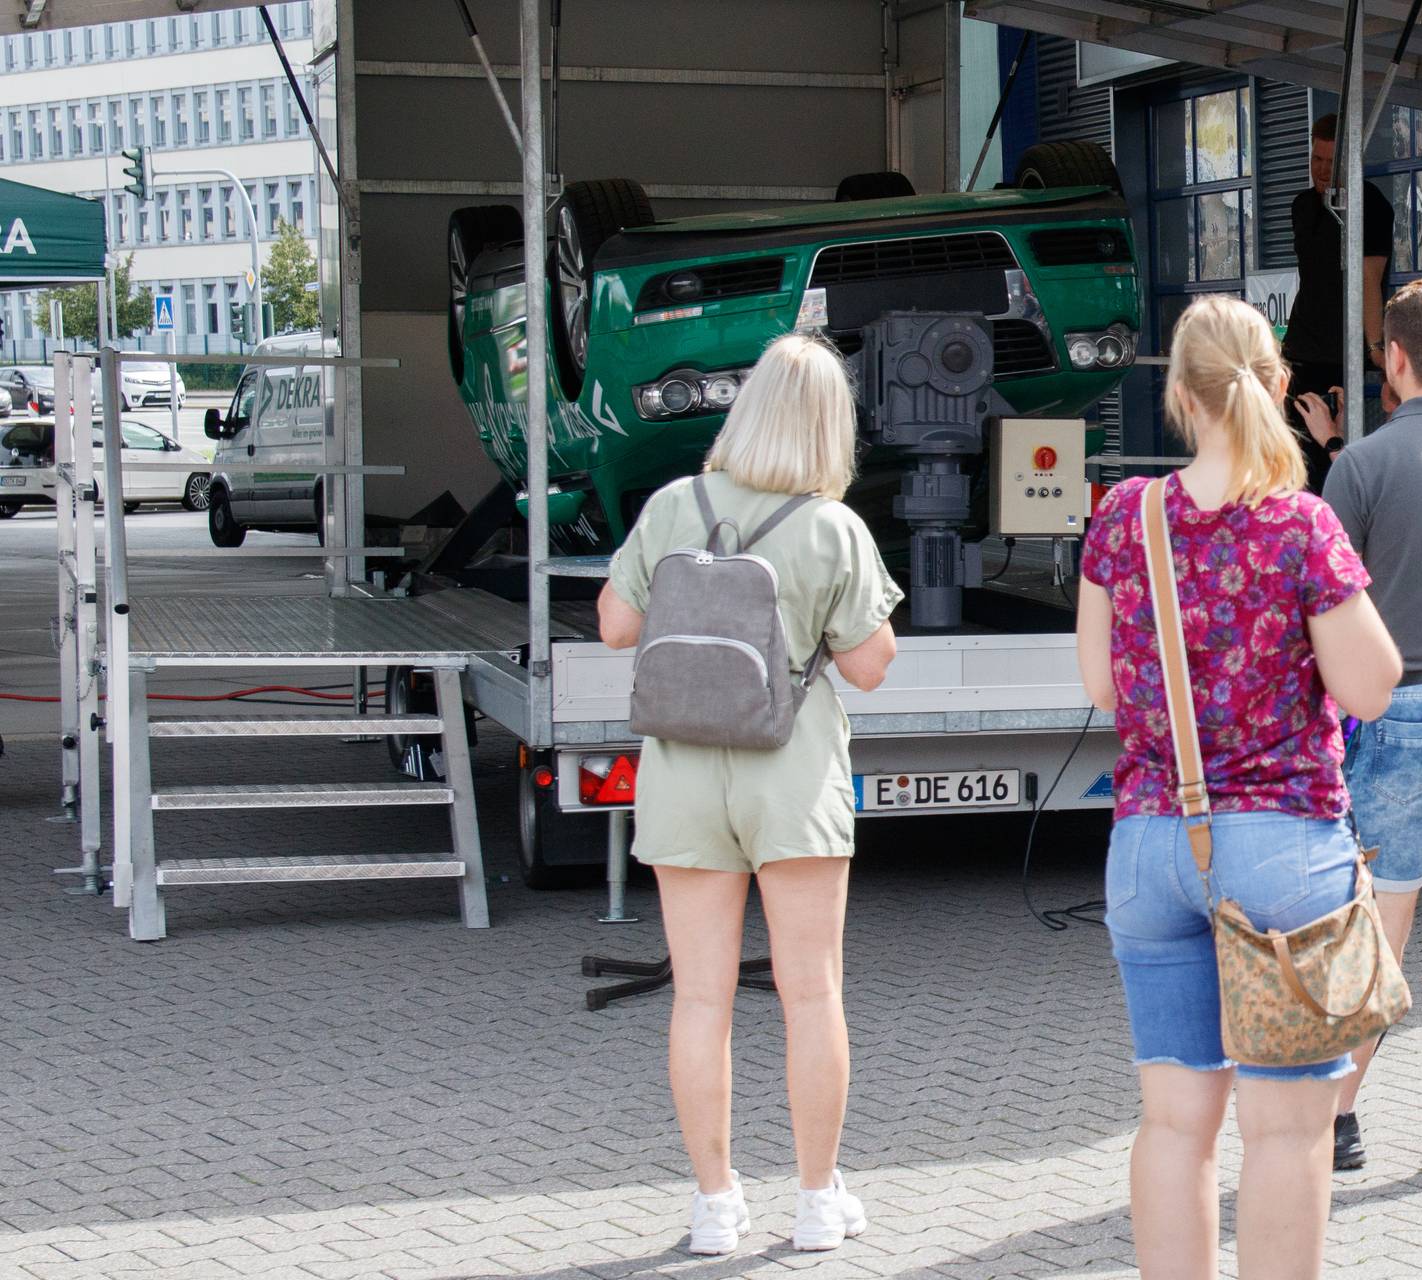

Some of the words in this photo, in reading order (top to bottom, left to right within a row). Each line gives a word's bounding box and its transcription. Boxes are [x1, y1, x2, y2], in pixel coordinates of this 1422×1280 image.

[277, 375, 320, 410] DEKRA
[877, 778, 894, 805] E
[914, 776, 949, 804] DE
[957, 774, 1008, 802] 616
